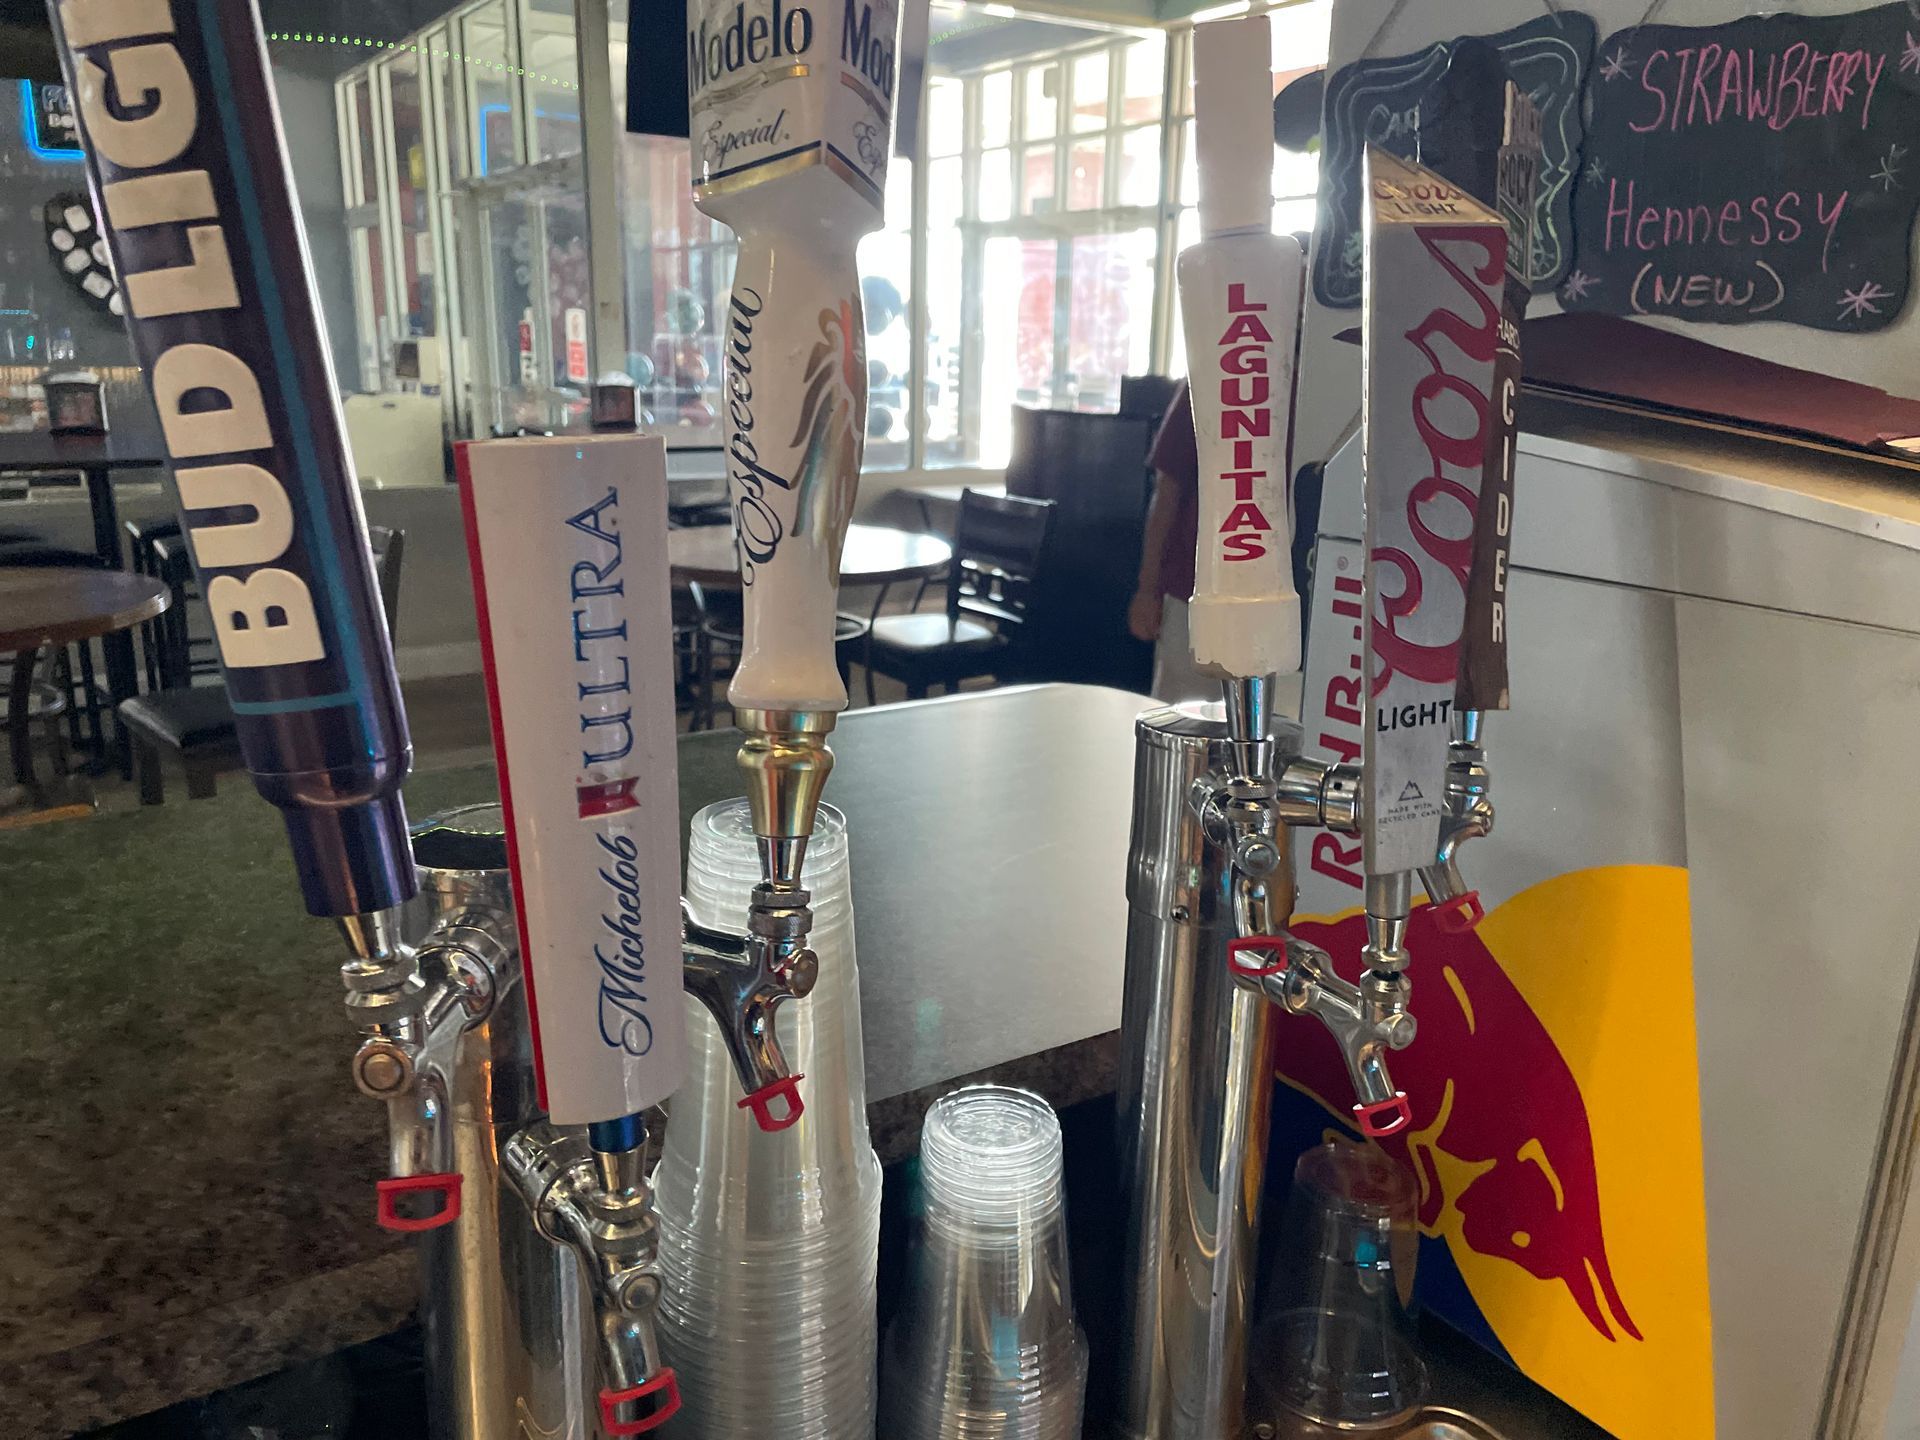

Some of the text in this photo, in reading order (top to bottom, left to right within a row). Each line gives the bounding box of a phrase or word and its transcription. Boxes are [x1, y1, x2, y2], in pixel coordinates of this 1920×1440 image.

[690, 0, 813, 97] Modelo
[1628, 42, 1886, 132] STRAWBERRY
[1374, 177, 1466, 201] Coors
[1394, 202, 1460, 215] LIGHT
[1631, 260, 1785, 315] (NEW)
[1218, 283, 1274, 562] LAGUNITAS
[1370, 226, 1509, 699] Coors
[152, 342, 326, 669] BUD
[1491, 377, 1515, 644] CIDER
[1377, 700, 1452, 732] LIGHT
[565, 486, 653, 1057] Michelob ULTRA
